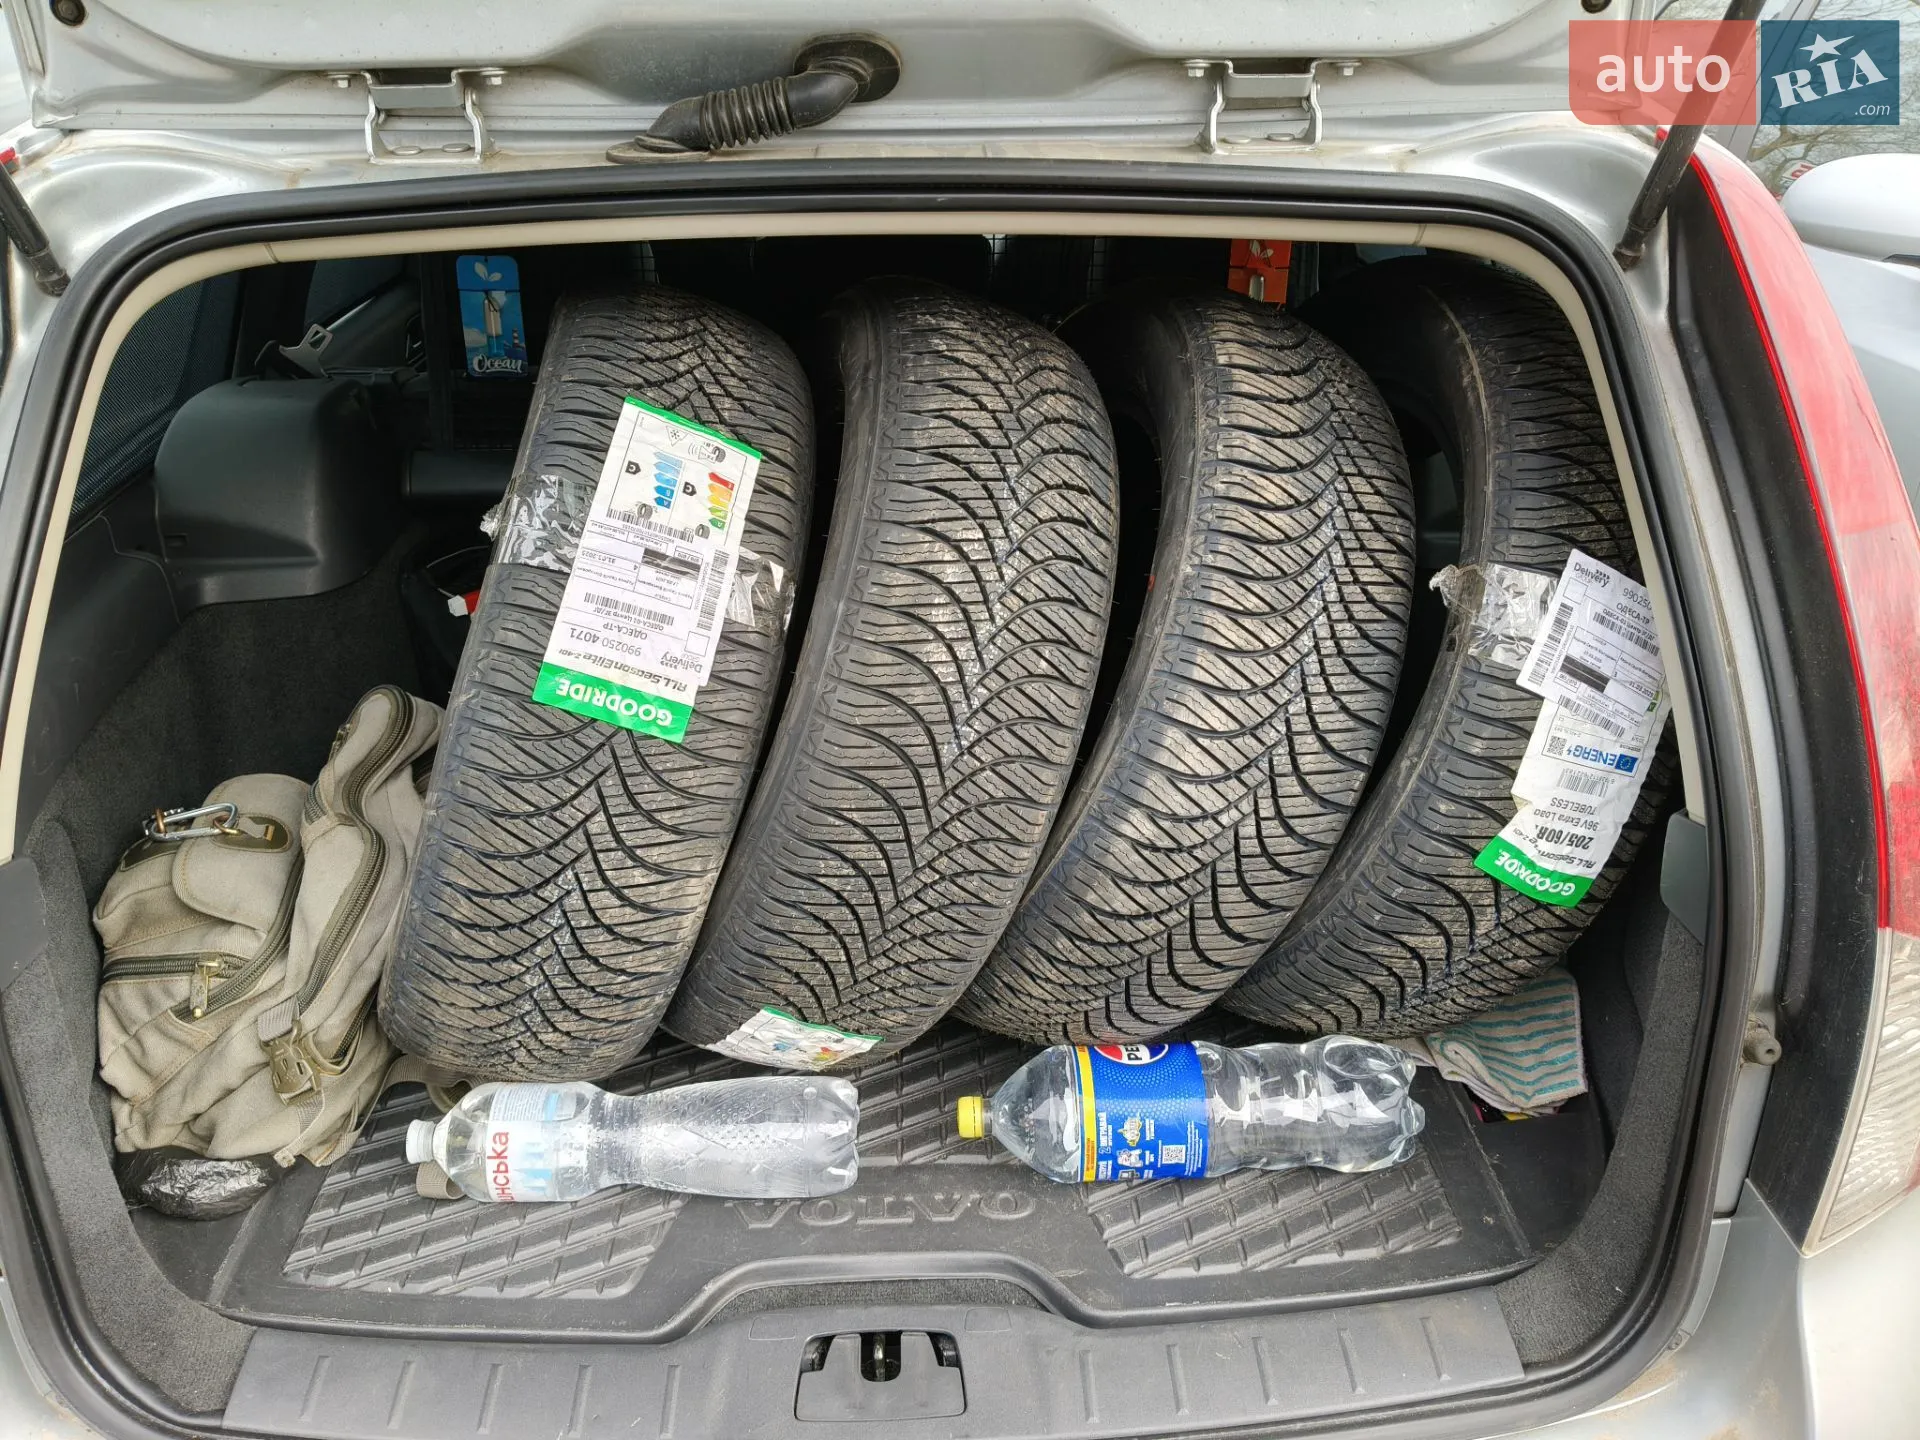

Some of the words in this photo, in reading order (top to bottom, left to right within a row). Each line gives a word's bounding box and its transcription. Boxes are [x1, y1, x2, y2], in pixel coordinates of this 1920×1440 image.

[472, 353, 524, 374] Ocean
[1572, 561, 1610, 588] Delivery
[1614, 601, 1650, 625] ОДЕСА-ТР
[567, 627, 599, 645] 4071
[602, 619, 648, 640] ОДЕСА-ТР
[601, 636, 642, 657] 990250
[660, 650, 702, 674] Delivery
[554, 676, 674, 728] GOODRIDE
[1572, 743, 1617, 767] ENERG
[1549, 796, 1596, 815] TUBELESS
[1556, 812, 1580, 827] Extra
[1579, 818, 1598, 830] 96V
[1534, 823, 1593, 850] 205/60R
[724, 1192, 1036, 1229] VOLVO
